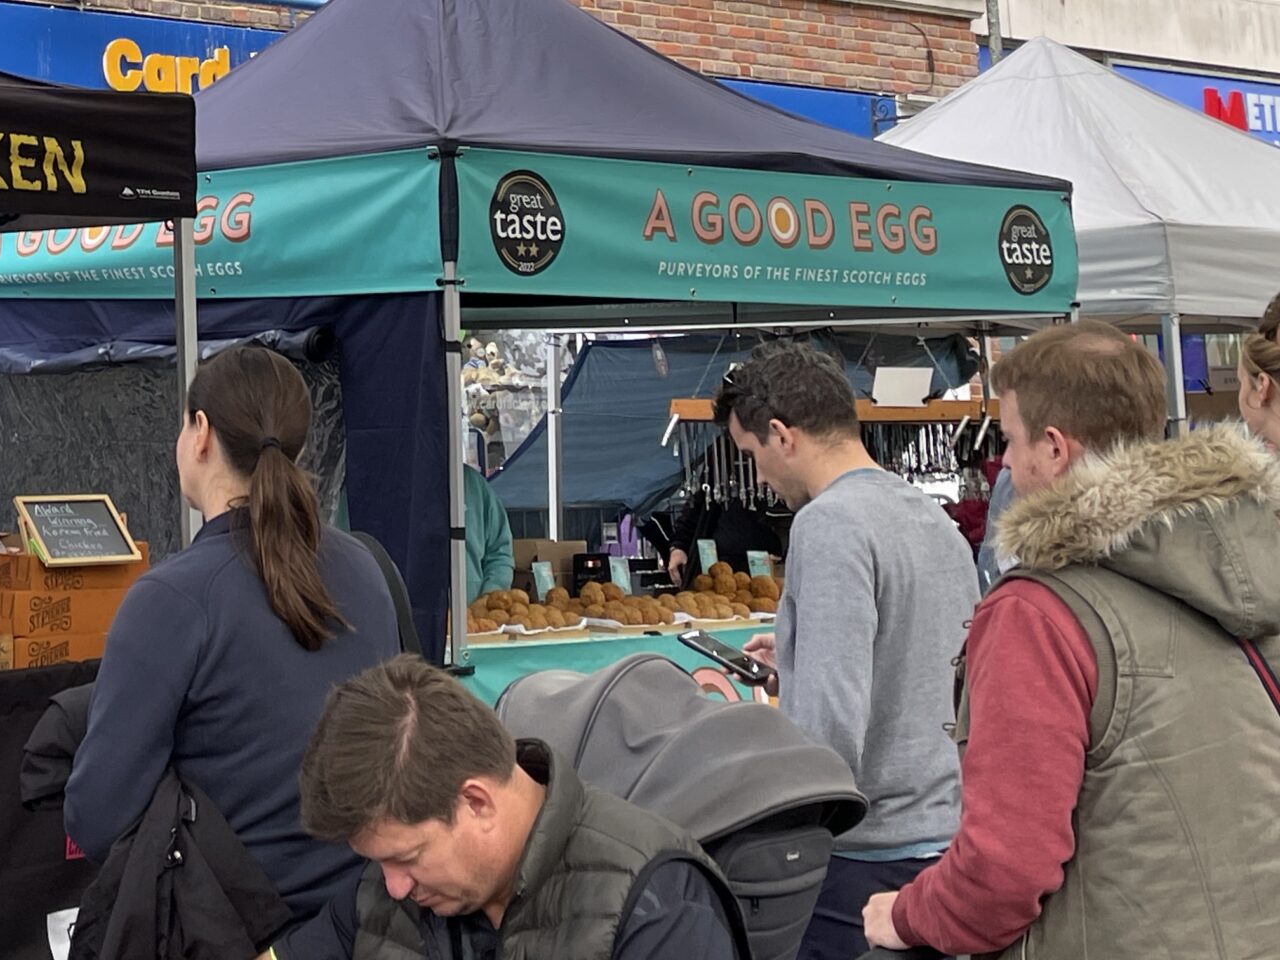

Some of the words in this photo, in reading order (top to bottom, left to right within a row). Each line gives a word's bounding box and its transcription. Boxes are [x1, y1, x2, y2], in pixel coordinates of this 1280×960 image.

[103, 38, 231, 95] Card
[509, 192, 545, 213] great
[493, 209, 562, 241] taste
[643, 188, 677, 242] A
[690, 190, 835, 250] GOOD
[848, 200, 938, 255] EGG
[1011, 224, 1038, 242] great
[1001, 239, 1052, 265] taste
[54, 269, 71, 282] OF
[73, 268, 98, 282] THE
[101, 265, 146, 281] FINEST
[149, 262, 203, 279] SCOH
[206, 261, 243, 277] EGGS
[657, 261, 739, 279] PURVEYORS
[743, 266, 762, 280] OF
[766, 267, 790, 281] THE
[795, 268, 839, 283] FINEST
[841, 269, 891, 285] SCOTCH
[895, 272, 928, 287] EGGS
